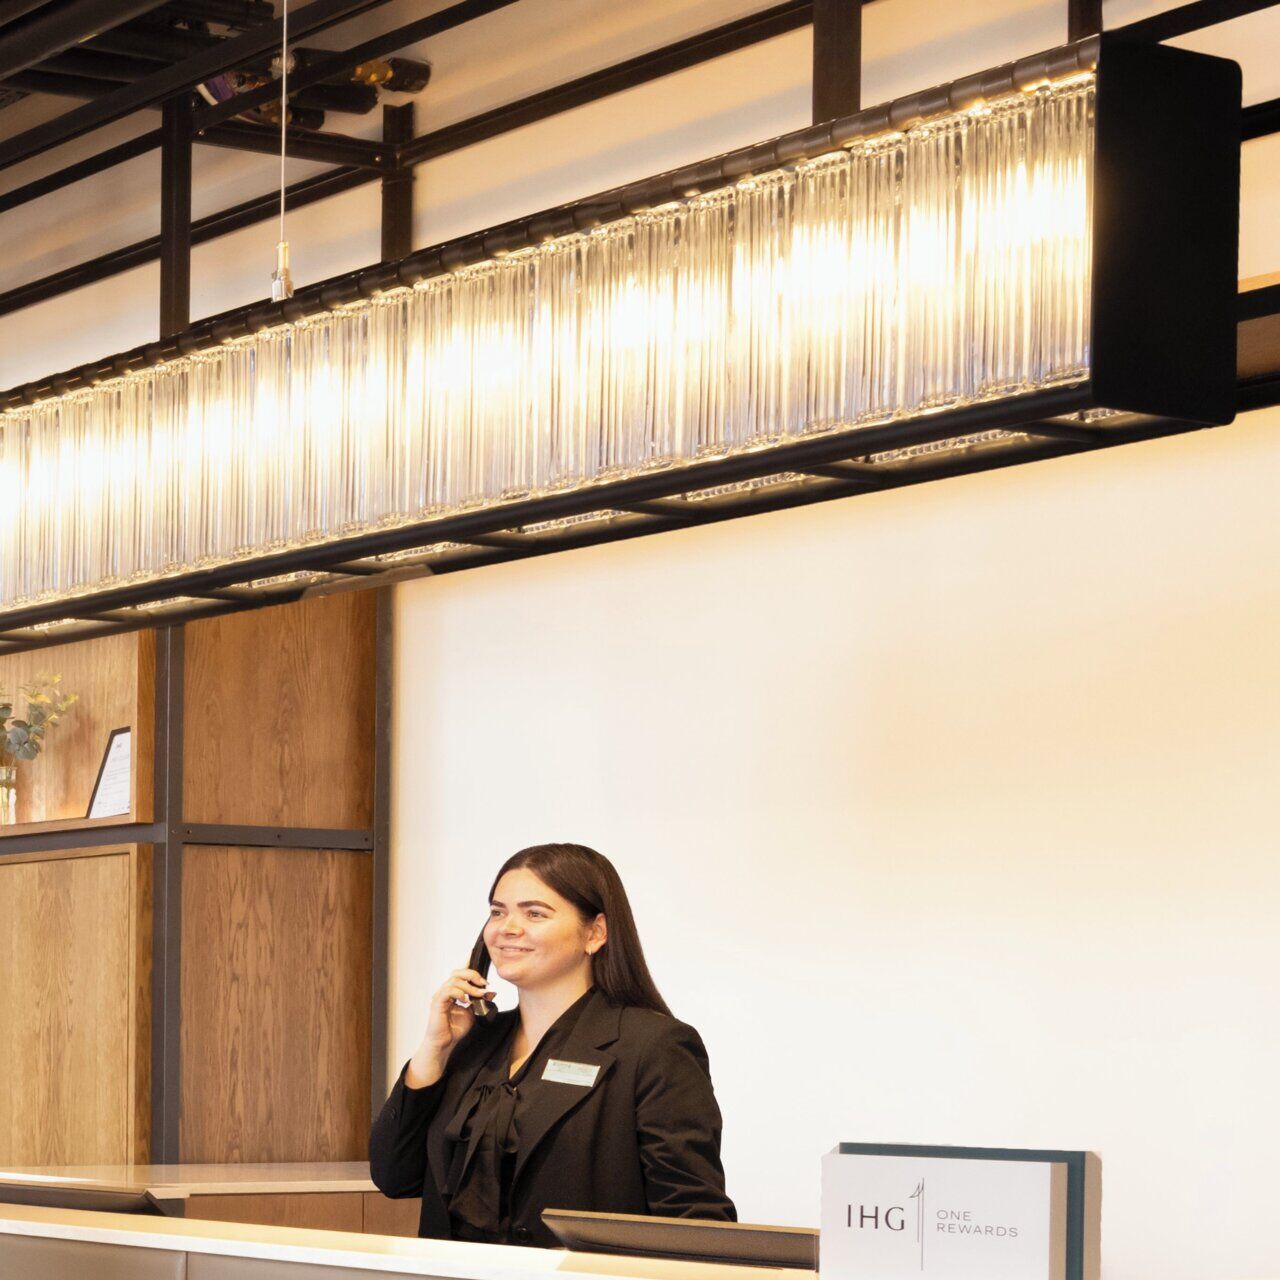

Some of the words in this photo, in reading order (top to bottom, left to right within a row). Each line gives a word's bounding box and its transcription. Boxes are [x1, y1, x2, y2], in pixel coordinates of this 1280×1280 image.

[847, 1204, 905, 1231] IHG
[936, 1209, 972, 1221] ONE
[936, 1222, 1019, 1237] REWARDS
